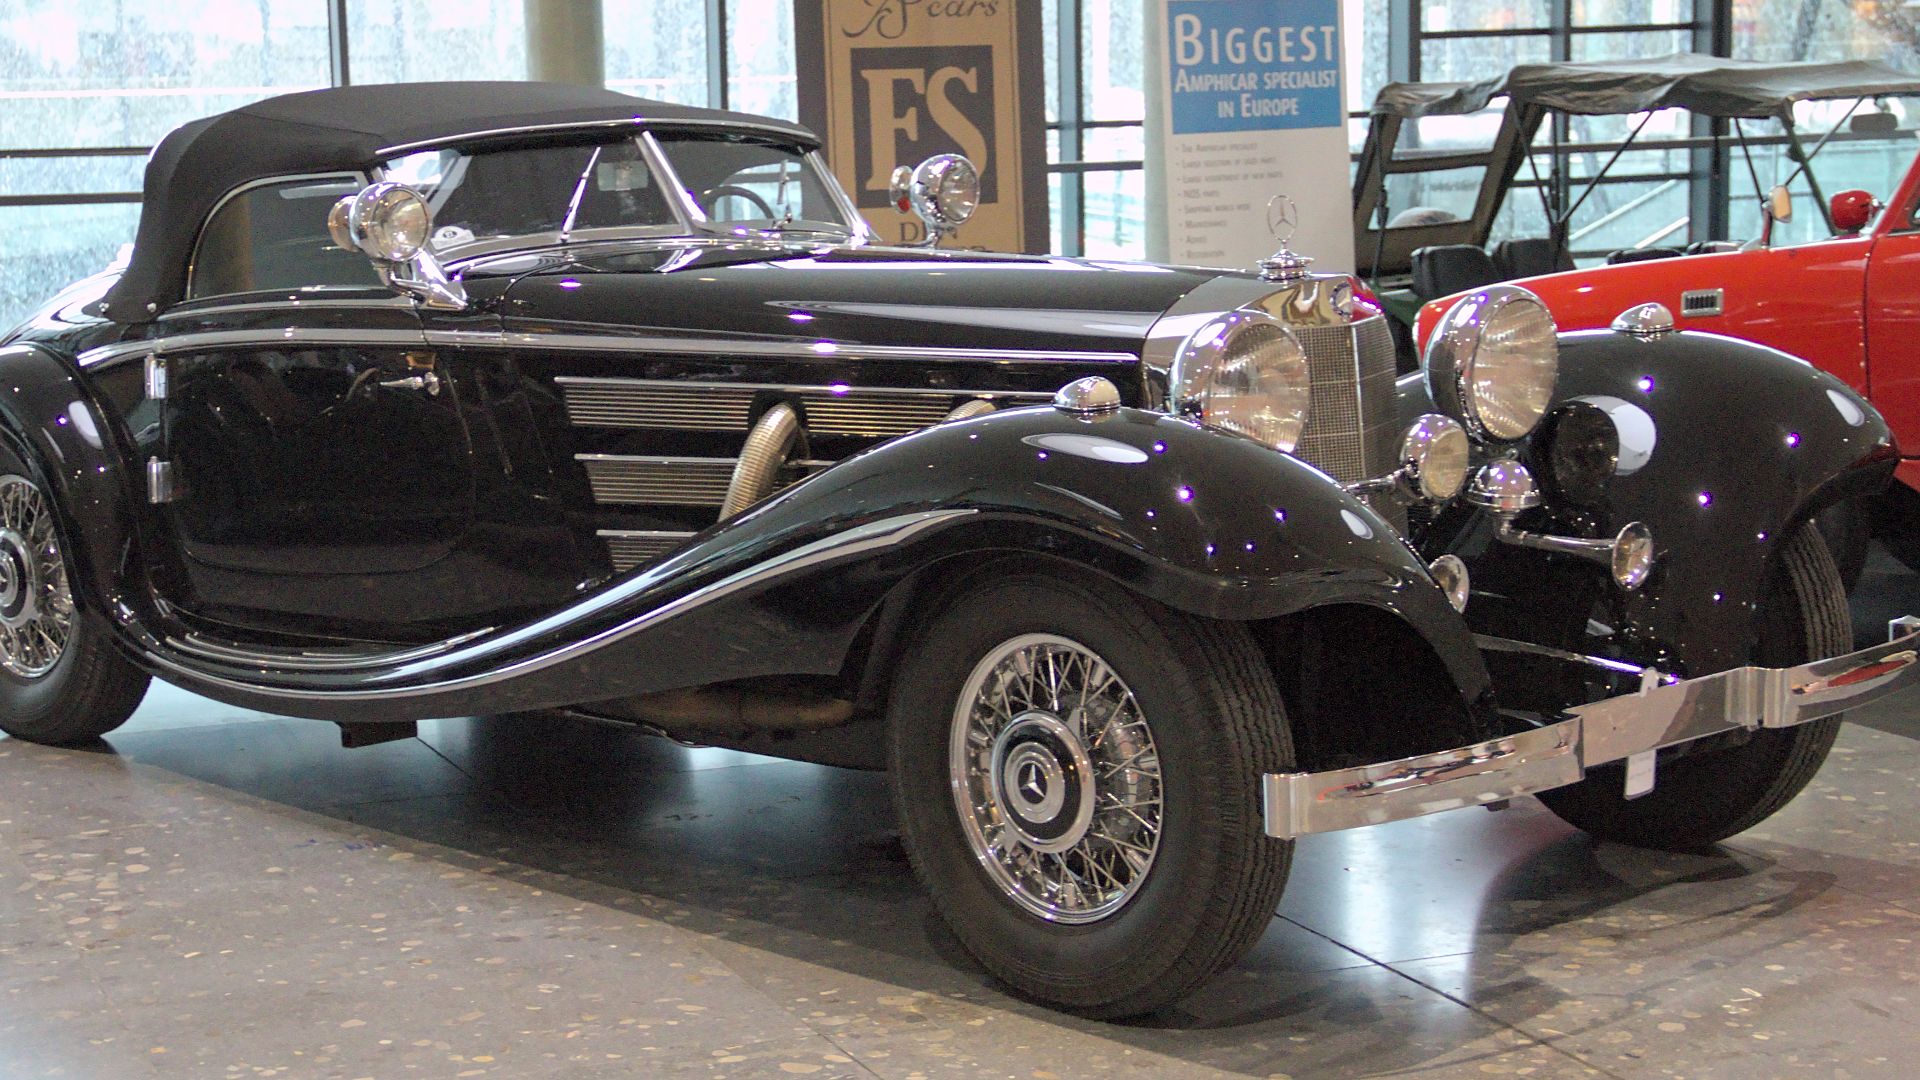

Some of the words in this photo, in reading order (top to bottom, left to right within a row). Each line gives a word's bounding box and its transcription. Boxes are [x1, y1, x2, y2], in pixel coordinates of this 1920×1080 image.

[1174, 13, 1336, 66] BIGGEST
[1174, 68, 1258, 93] AMPHICAR
[1263, 70, 1337, 90] SPECIALIST
[1217, 100, 1235, 118] IN
[1240, 93, 1299, 118] EUROPE
